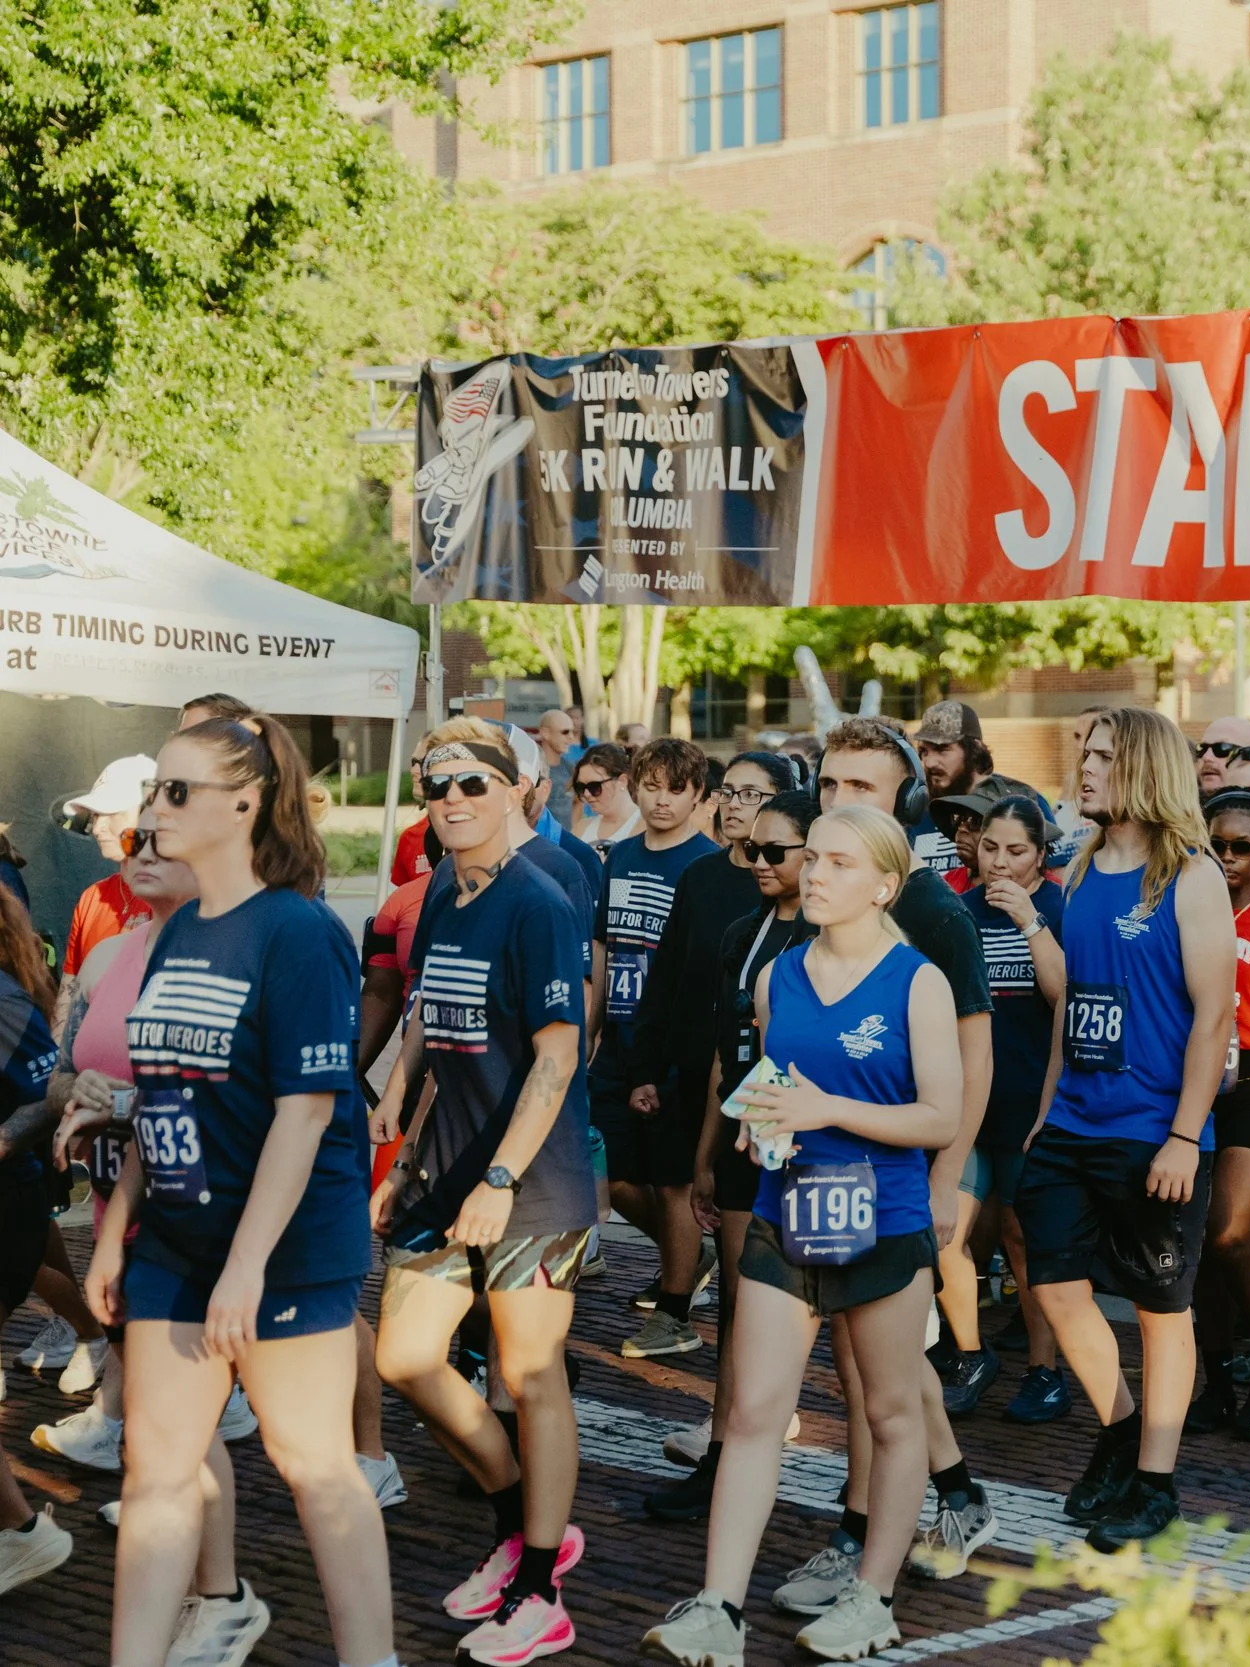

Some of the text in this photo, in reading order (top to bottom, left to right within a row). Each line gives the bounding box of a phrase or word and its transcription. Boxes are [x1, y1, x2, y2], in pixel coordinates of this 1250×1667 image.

[655, 364, 730, 402] Towers
[539, 449, 572, 492] 5K
[651, 447, 676, 492] &
[685, 446, 776, 492] WALK
[669, 541, 686, 556] BY
[654, 569, 705, 590] Health
[53, 613, 145, 646] TIMING
[154, 625, 250, 655] DURING
[258, 635, 336, 660] EVENT
[7, 645, 37, 670] at
[620, 911, 641, 928] FOR
[987, 963, 1035, 979] HEROES
[423, 1003, 439, 1025] OR
[441, 1006, 488, 1029] HEROES
[1067, 1001, 1123, 1042] 1258
[141, 1022, 165, 1047] FOR
[166, 1024, 234, 1056] HEROES
[132, 1115, 200, 1166] 1933
[784, 1186, 873, 1232] 1196
